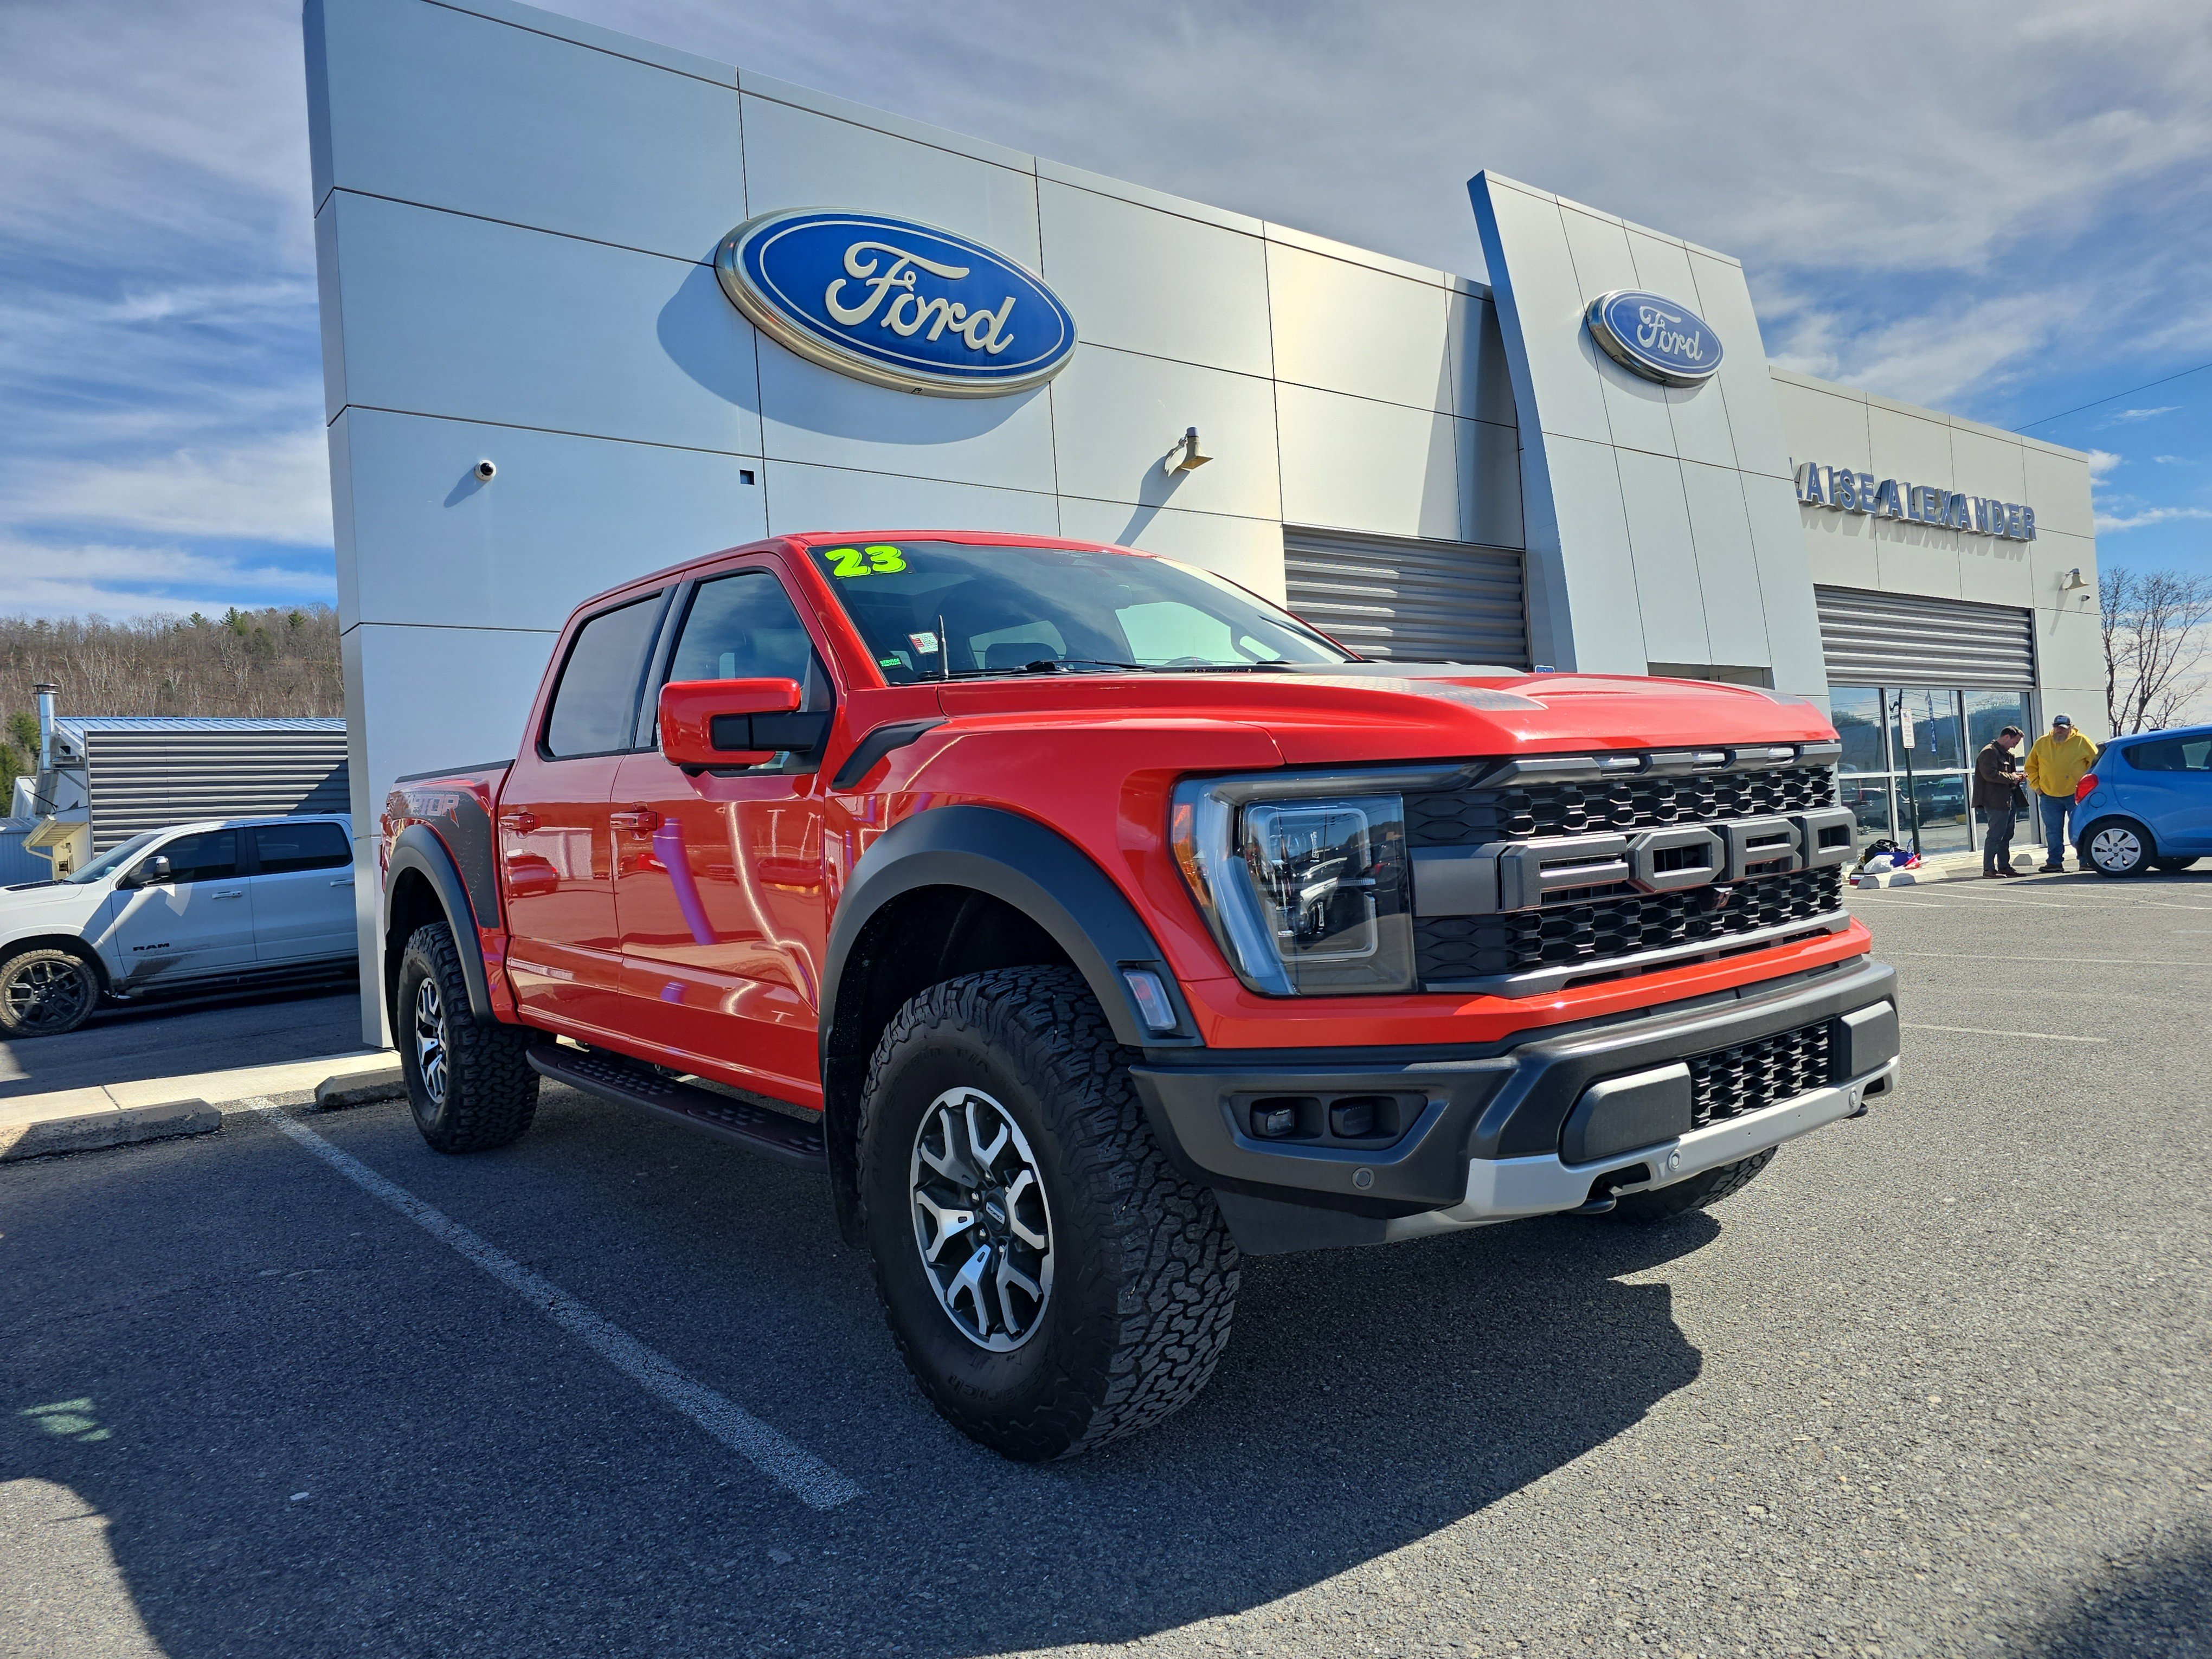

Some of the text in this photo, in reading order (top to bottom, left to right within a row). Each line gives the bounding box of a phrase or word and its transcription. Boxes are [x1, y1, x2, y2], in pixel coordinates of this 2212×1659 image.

[825, 241, 1016, 355] Ford
[1636, 306, 1703, 361] Ford
[1789, 456, 2037, 542] AISE ALEXANDER
[825, 545, 907, 577] 23
[1500, 807, 1857, 912] FORD
[133, 943, 170, 951] RAM
